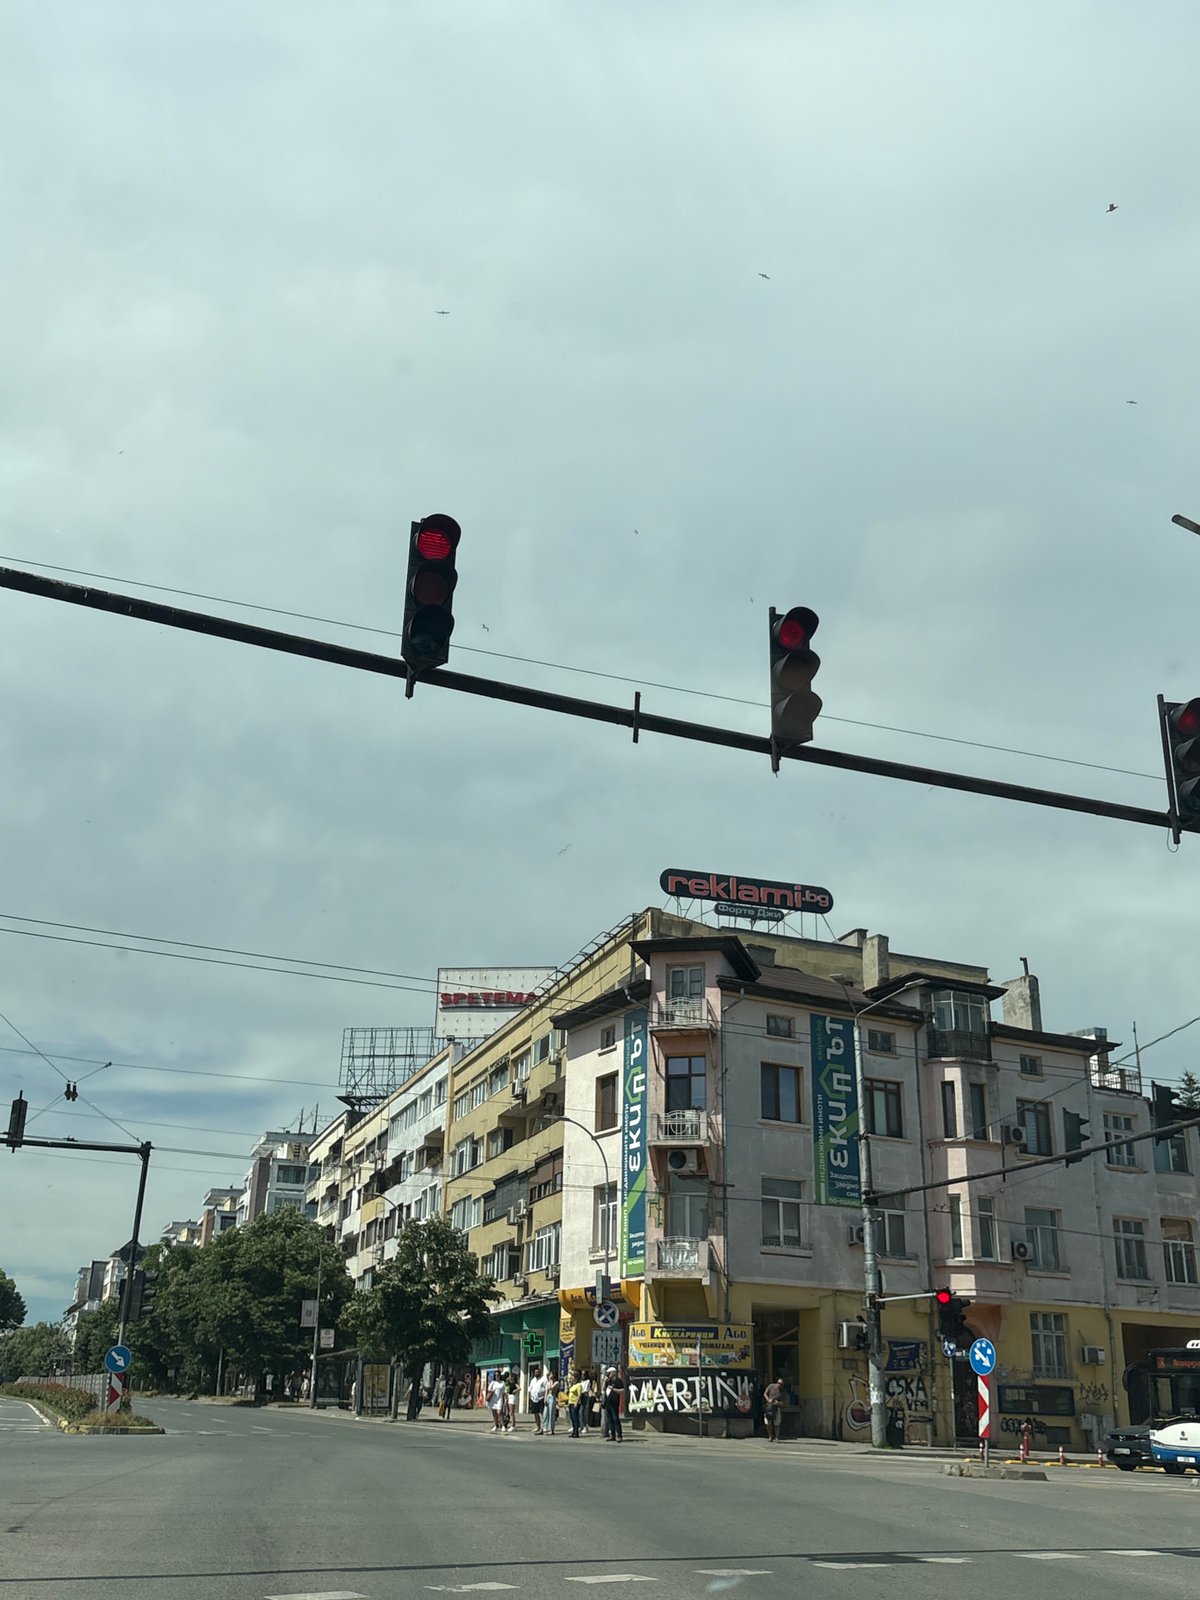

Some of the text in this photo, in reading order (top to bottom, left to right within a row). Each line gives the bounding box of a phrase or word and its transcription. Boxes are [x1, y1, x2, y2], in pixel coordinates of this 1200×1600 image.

[667, 874, 830, 908] reklami.bg
[718, 904, 782, 919] Форте Джи
[440, 991, 537, 1005] SPETEMA
